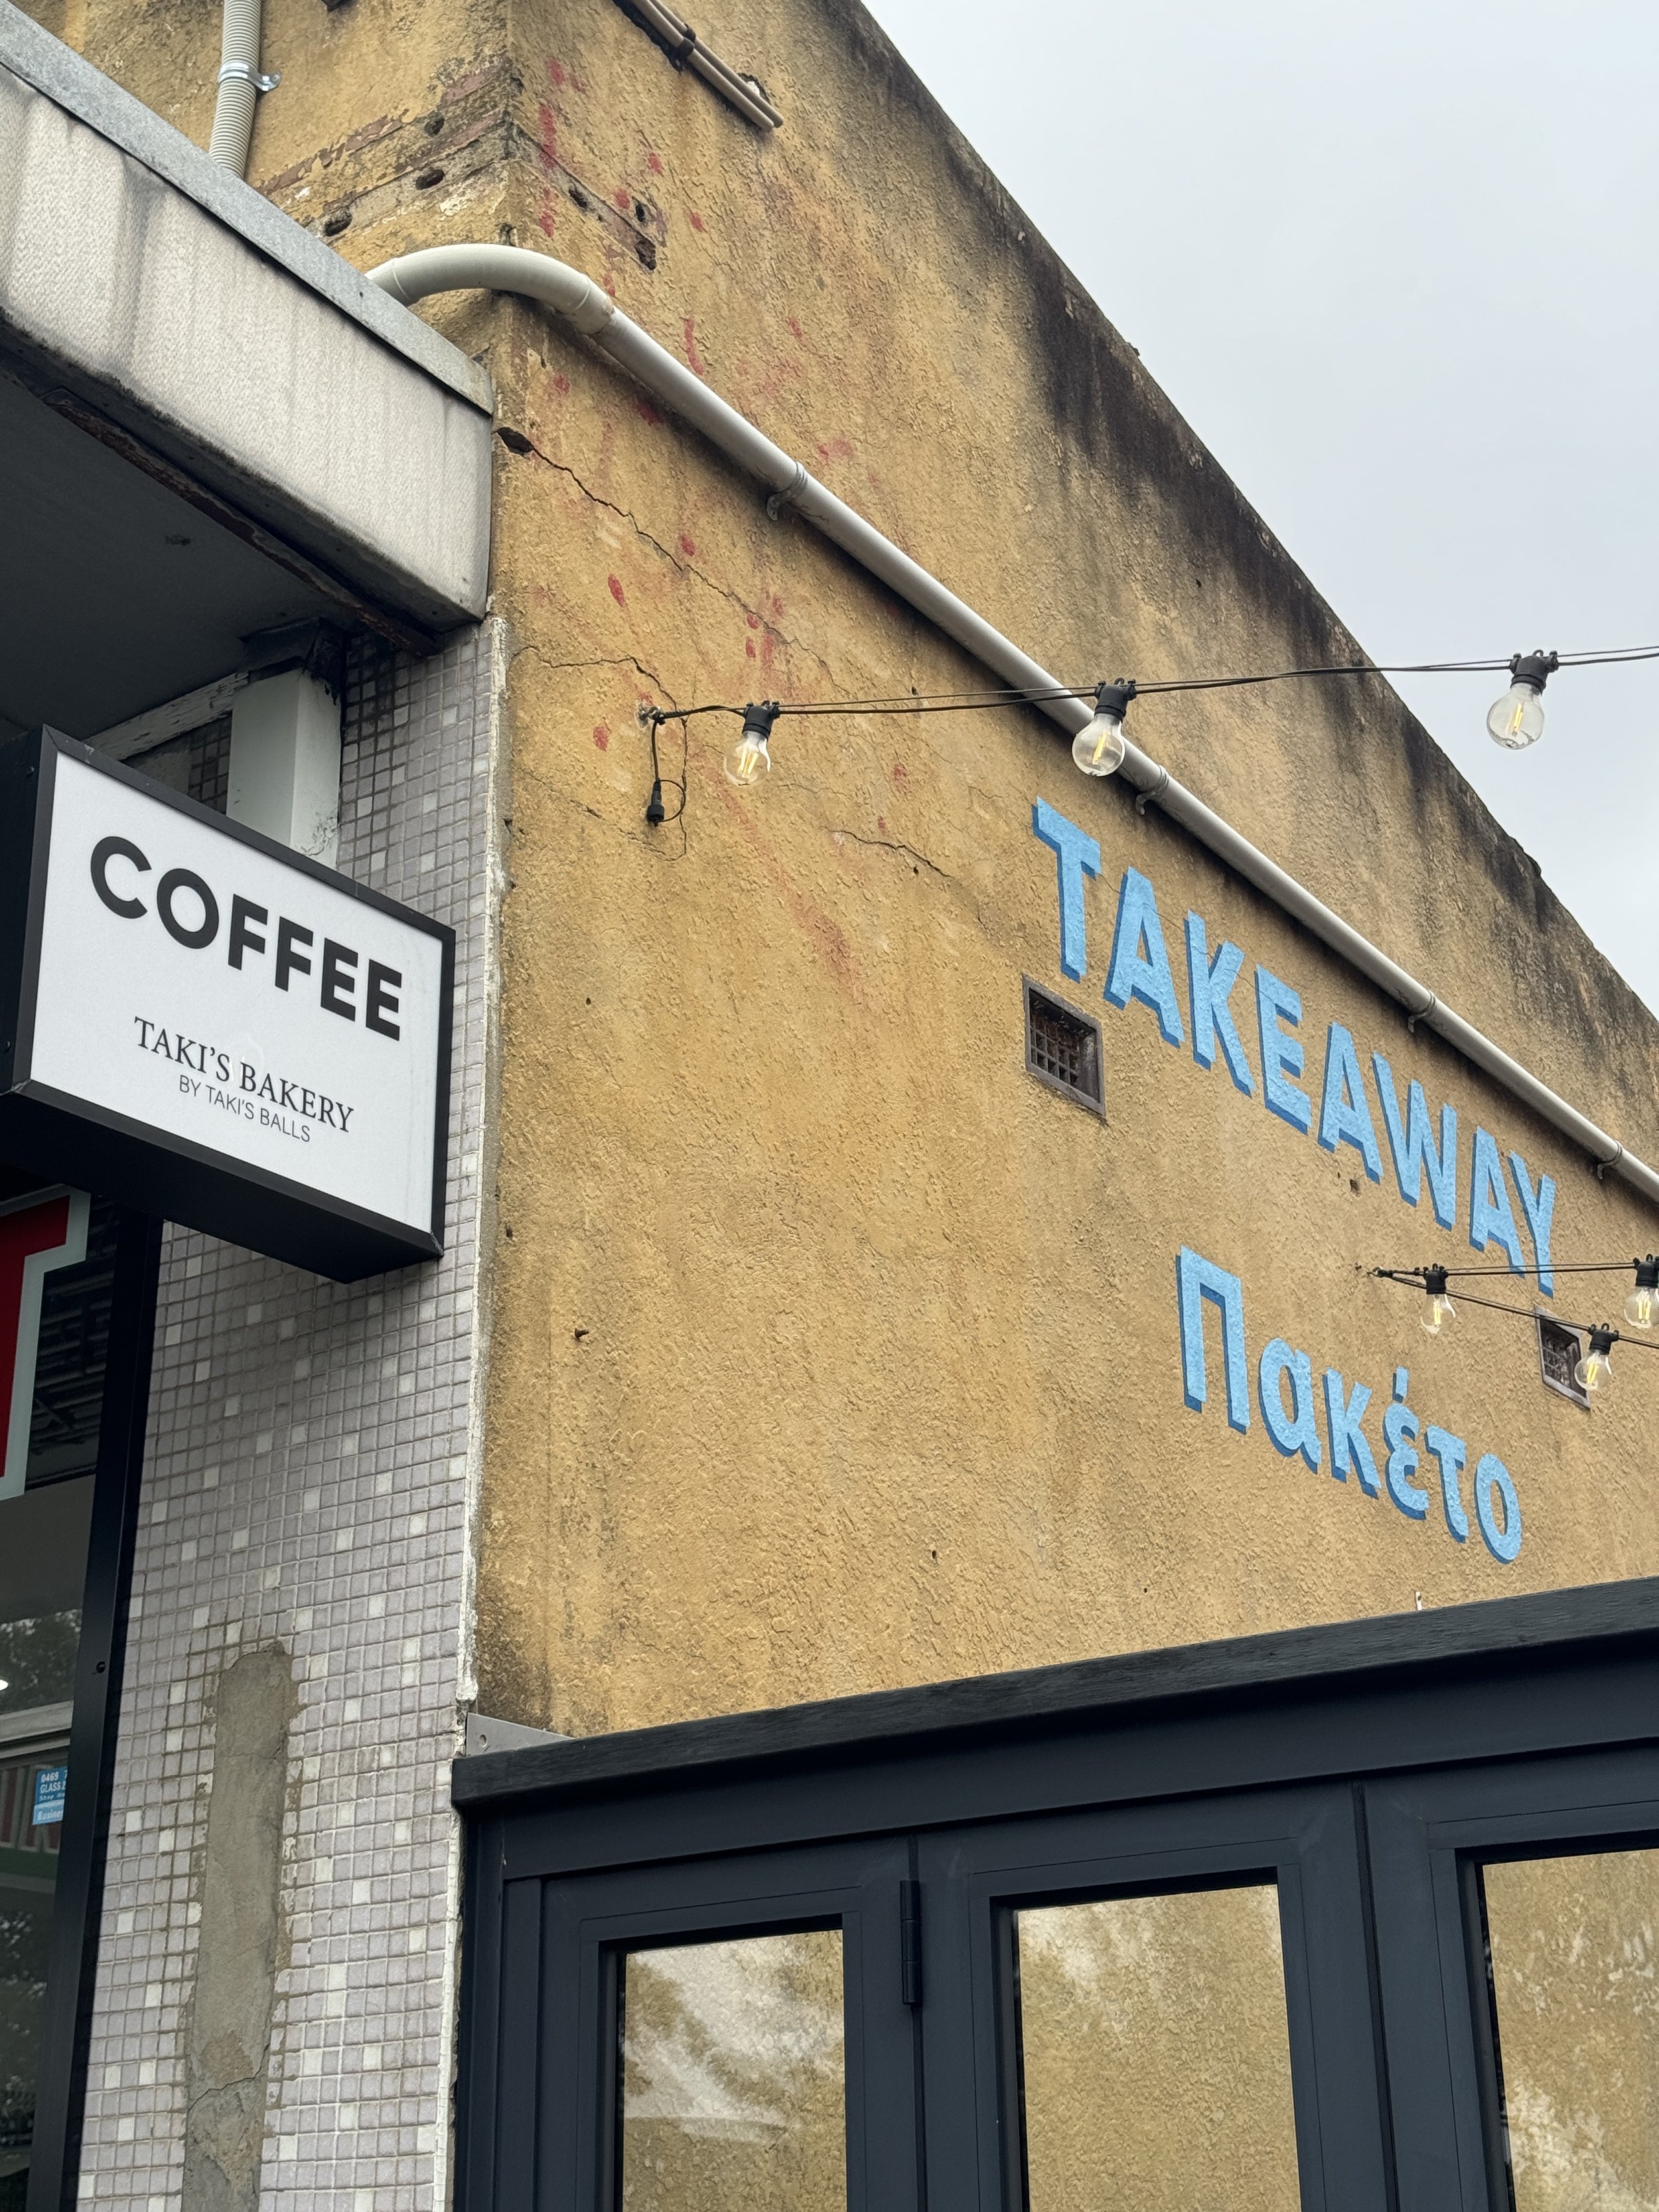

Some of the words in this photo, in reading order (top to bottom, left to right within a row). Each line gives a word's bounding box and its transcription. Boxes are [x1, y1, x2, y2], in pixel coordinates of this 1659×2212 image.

[90, 836, 402, 1042] COFFEE
[134, 1016, 230, 1082] TAKI'S
[239, 1062, 355, 1134] BAKERY
[179, 1074, 201, 1096] BY
[206, 1084, 255, 1120] TAKI'S
[259, 1108, 311, 1143] BALLS
[1032, 796, 1557, 1297] TAKEAWAY
[1176, 1246, 1522, 1565] Πακέτο
[40, 1781, 61, 1794] GLASS
